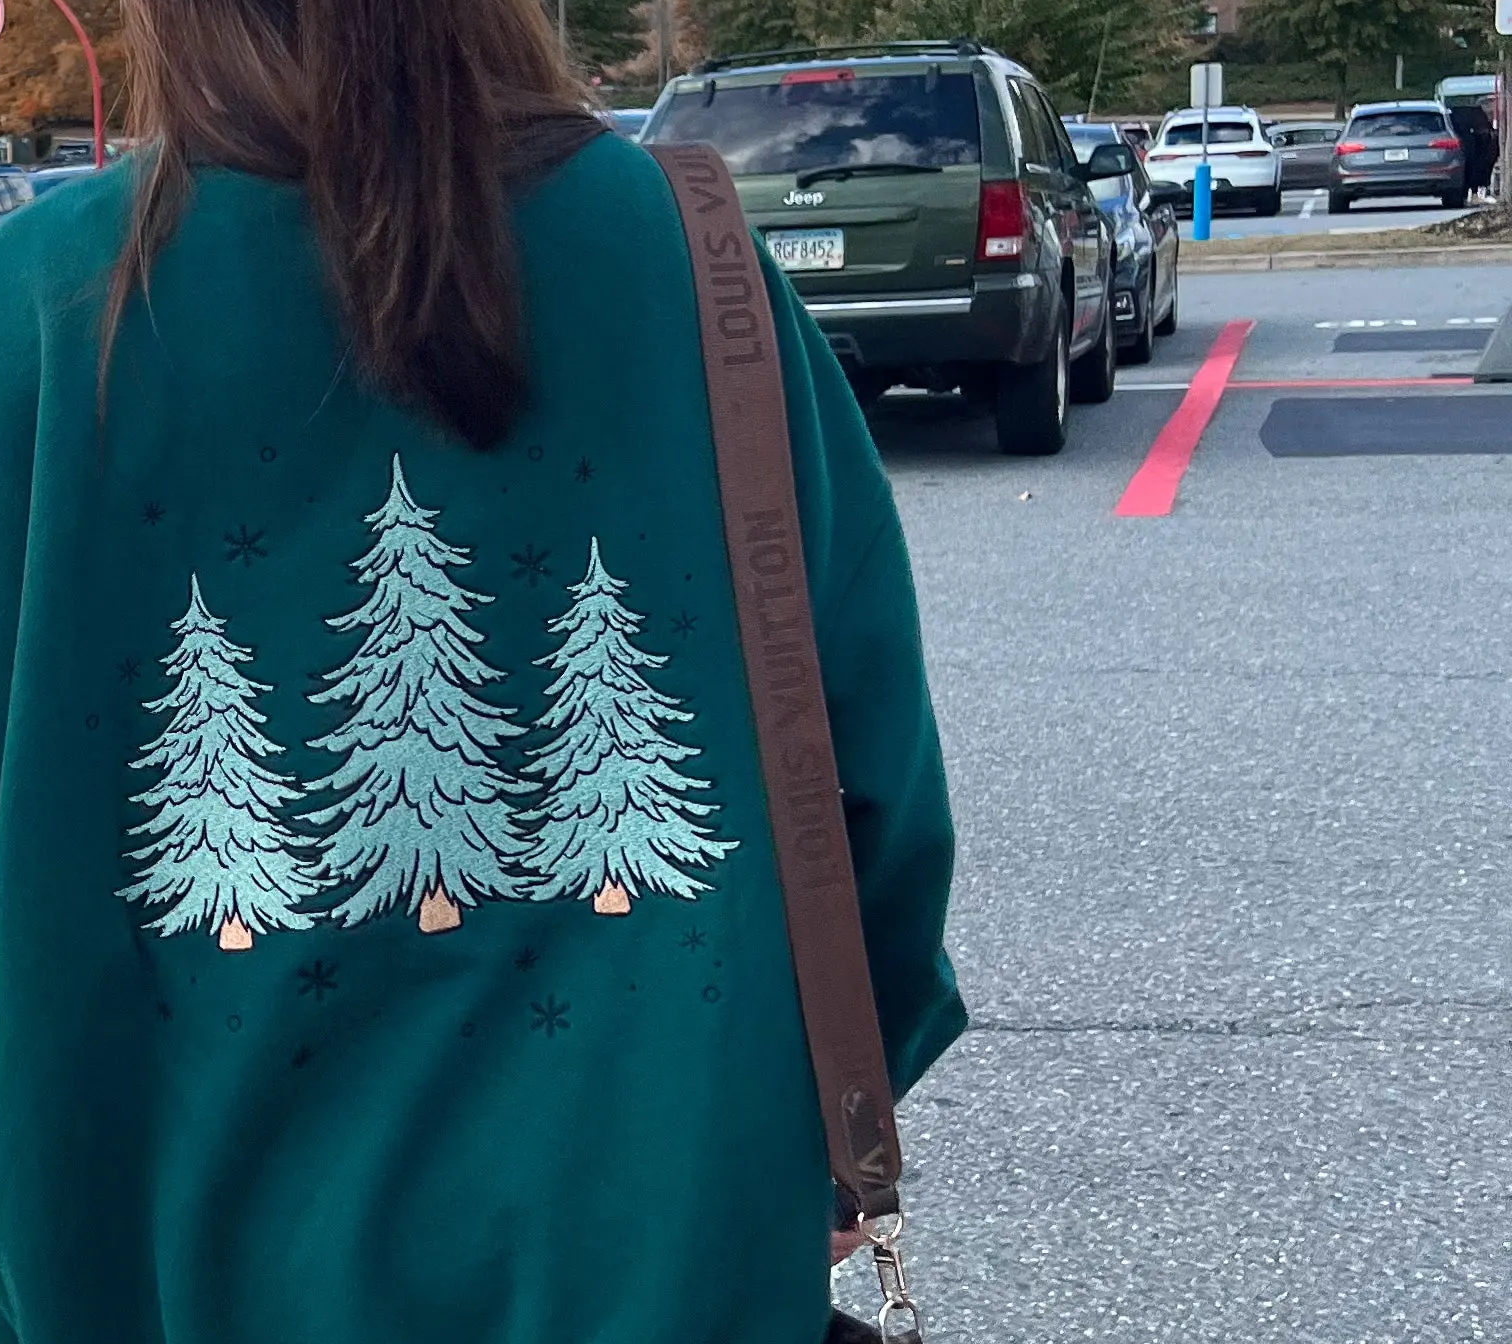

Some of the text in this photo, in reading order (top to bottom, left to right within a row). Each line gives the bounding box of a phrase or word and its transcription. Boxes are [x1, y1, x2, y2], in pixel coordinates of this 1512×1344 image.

[783, 191, 824, 207] Jeep
[774, 240, 835, 260] RGF8452
[702, 230, 766, 367] LOUIS
[742, 508, 812, 732] VUITTON
